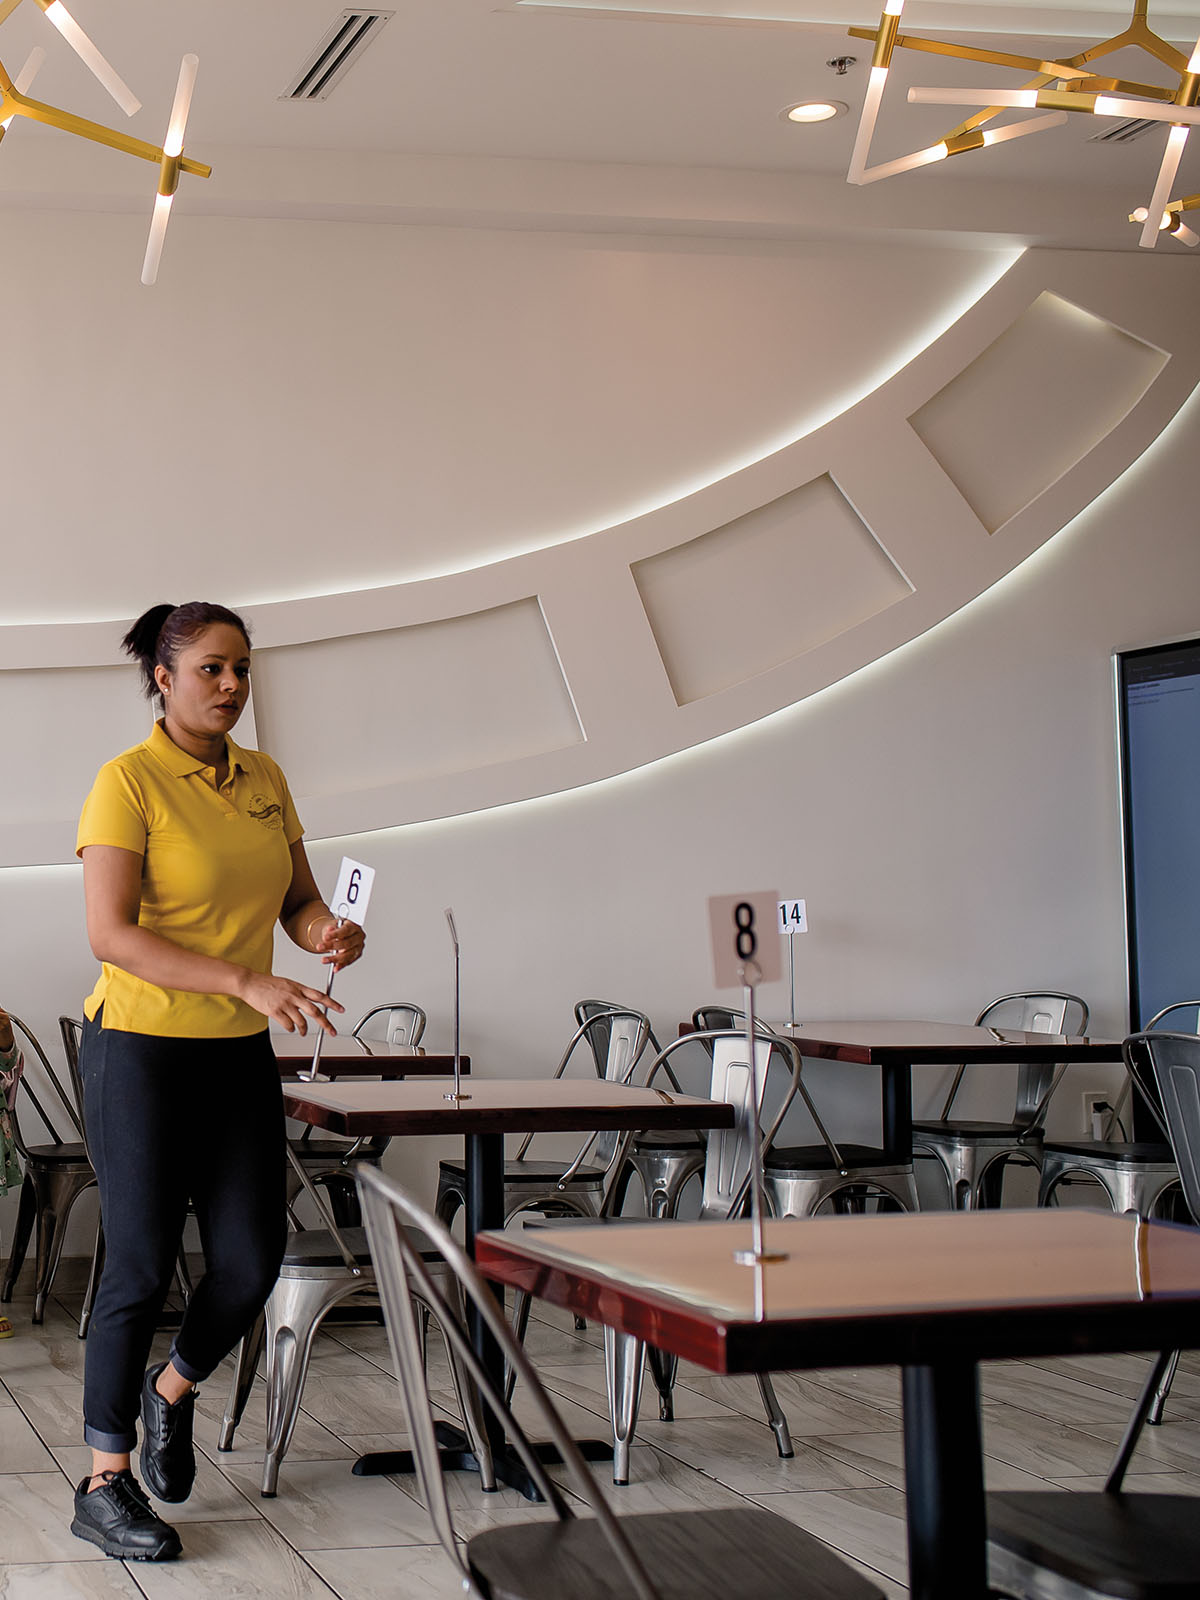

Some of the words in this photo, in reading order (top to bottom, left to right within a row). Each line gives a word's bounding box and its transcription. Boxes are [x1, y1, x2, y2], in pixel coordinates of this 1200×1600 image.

[347, 868, 361, 904] 6
[735, 902, 756, 960] 8
[779, 903, 801, 925] 14
